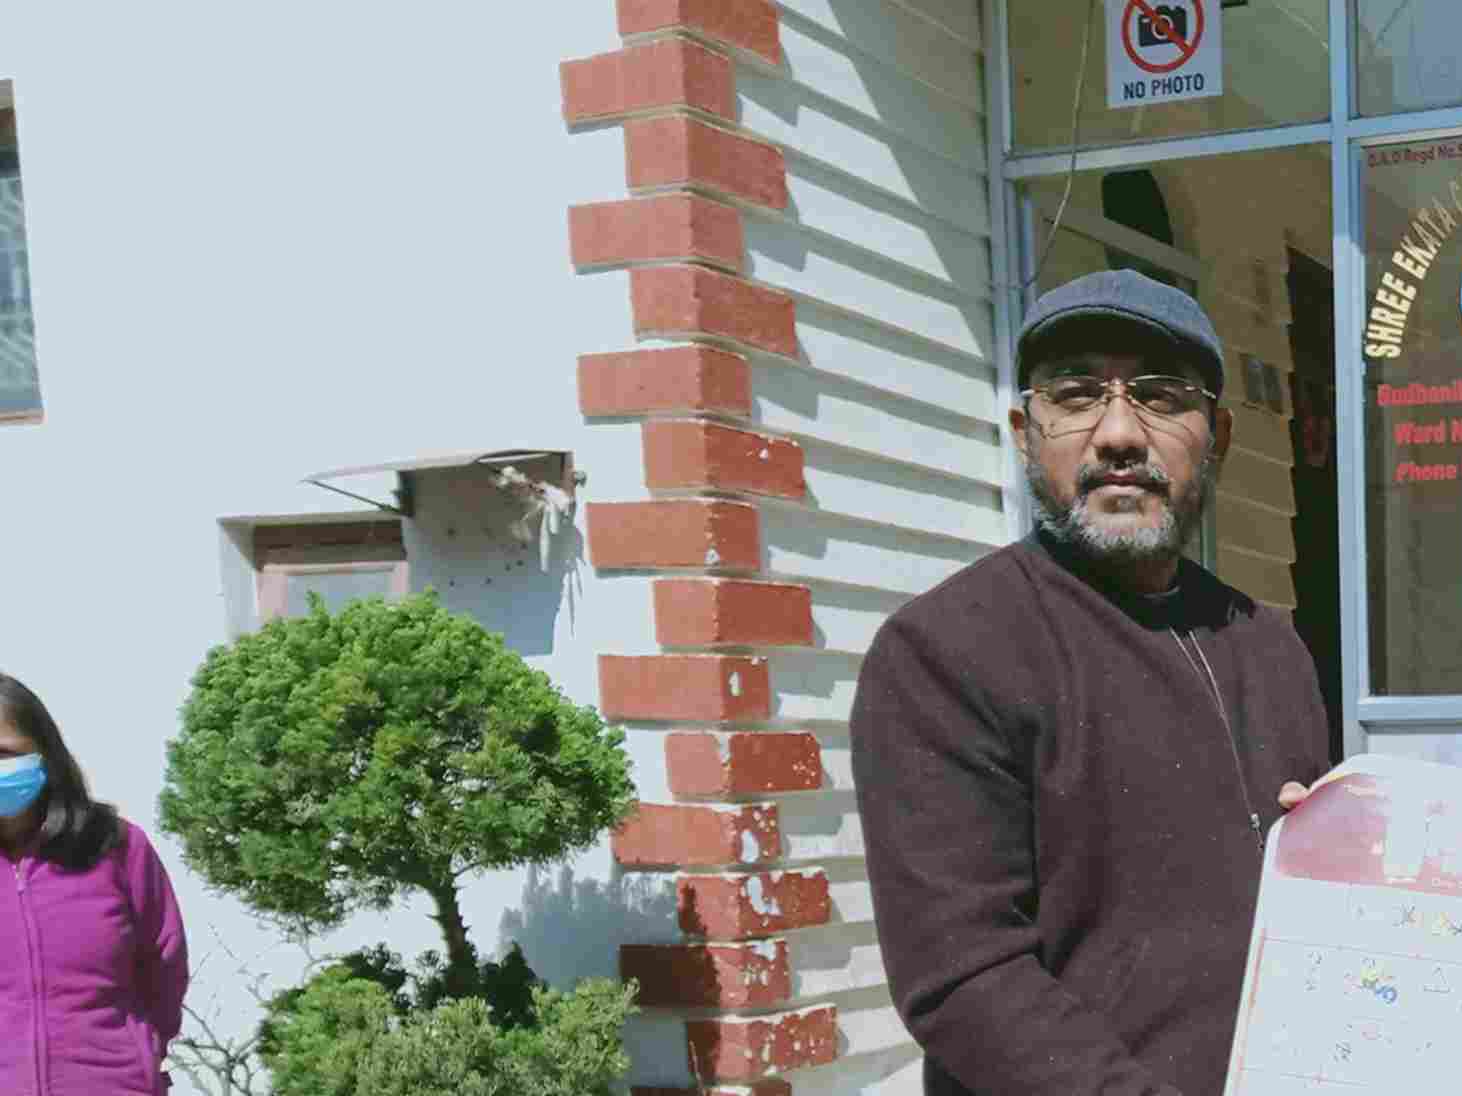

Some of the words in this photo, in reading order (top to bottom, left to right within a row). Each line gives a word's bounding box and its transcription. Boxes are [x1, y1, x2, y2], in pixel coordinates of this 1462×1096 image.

[1124, 81, 1146, 100] NO
[1151, 73, 1204, 96] PHOTO
[1365, 272, 1416, 358] SHREE
[1392, 195, 1457, 280] EKATA
[1393, 419, 1446, 447] Ward
[1393, 462, 1457, 481] Phone
